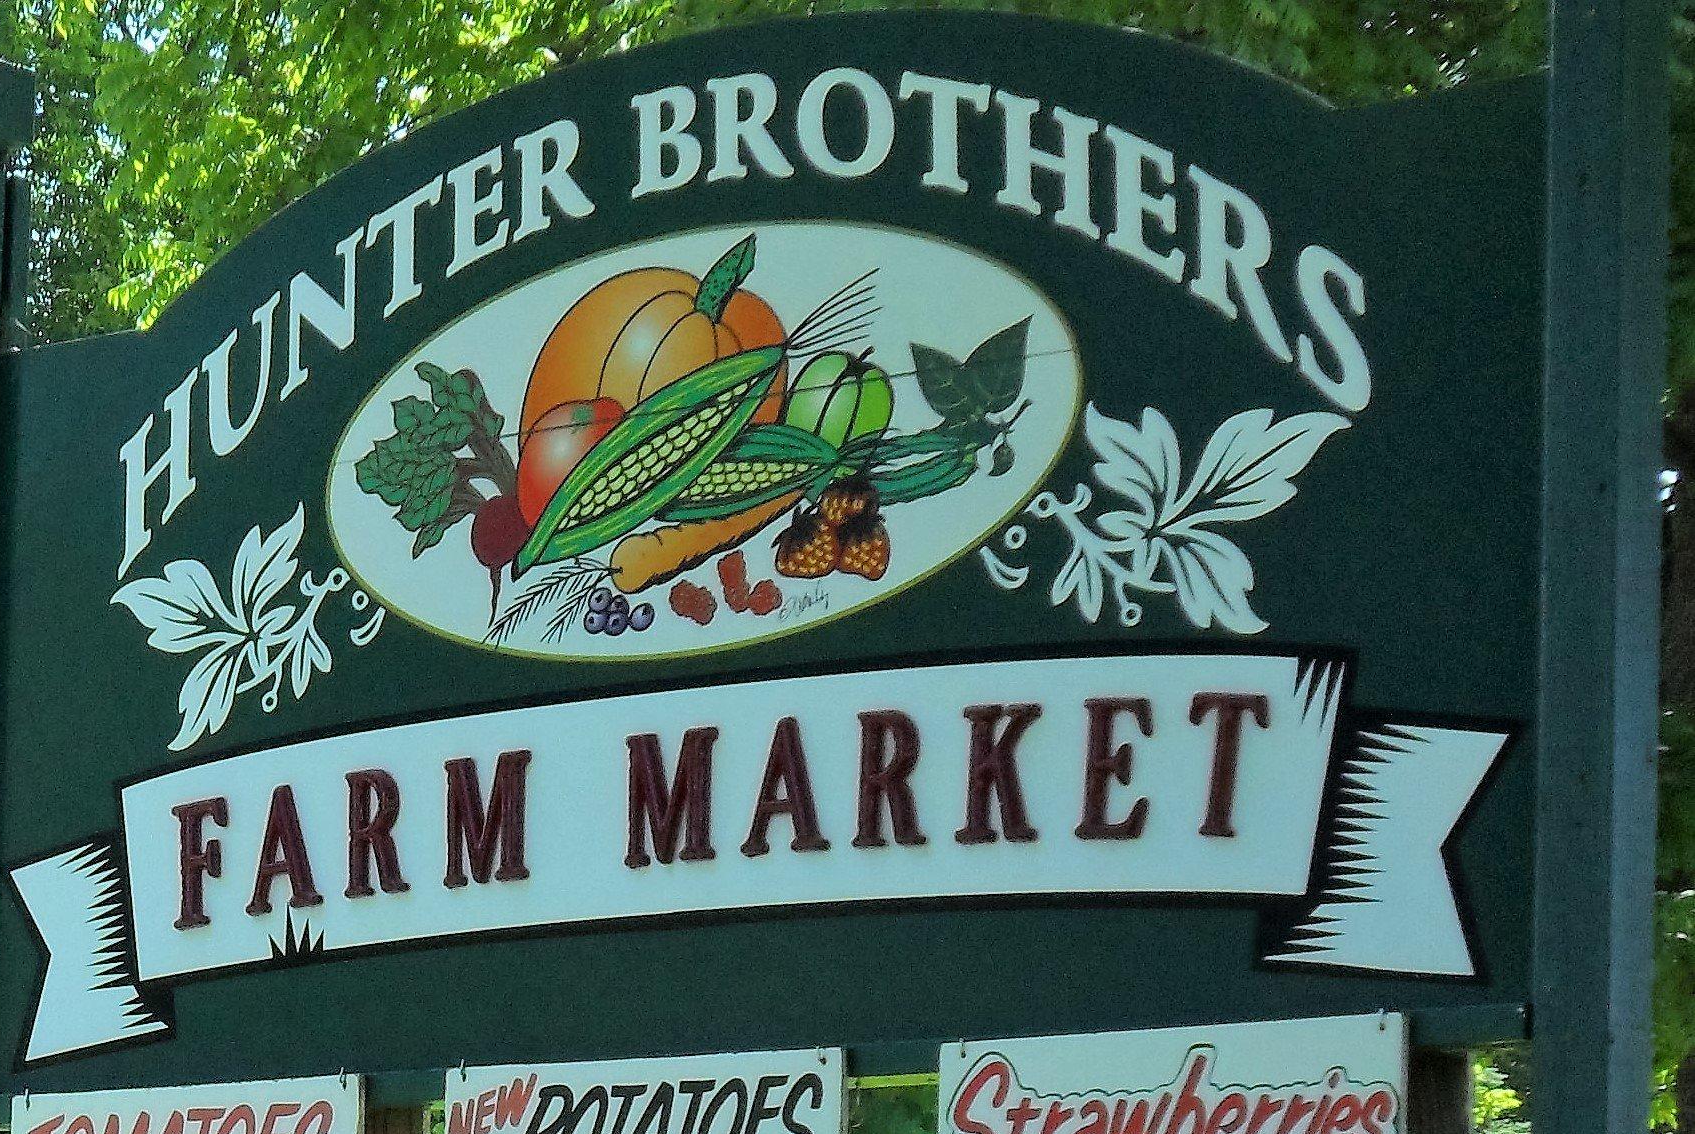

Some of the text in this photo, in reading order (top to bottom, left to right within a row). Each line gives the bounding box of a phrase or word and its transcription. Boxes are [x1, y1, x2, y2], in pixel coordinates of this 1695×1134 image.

[118, 66, 1372, 580] HUNTER BROTHERS
[171, 691, 1270, 931] FARM MARKET
